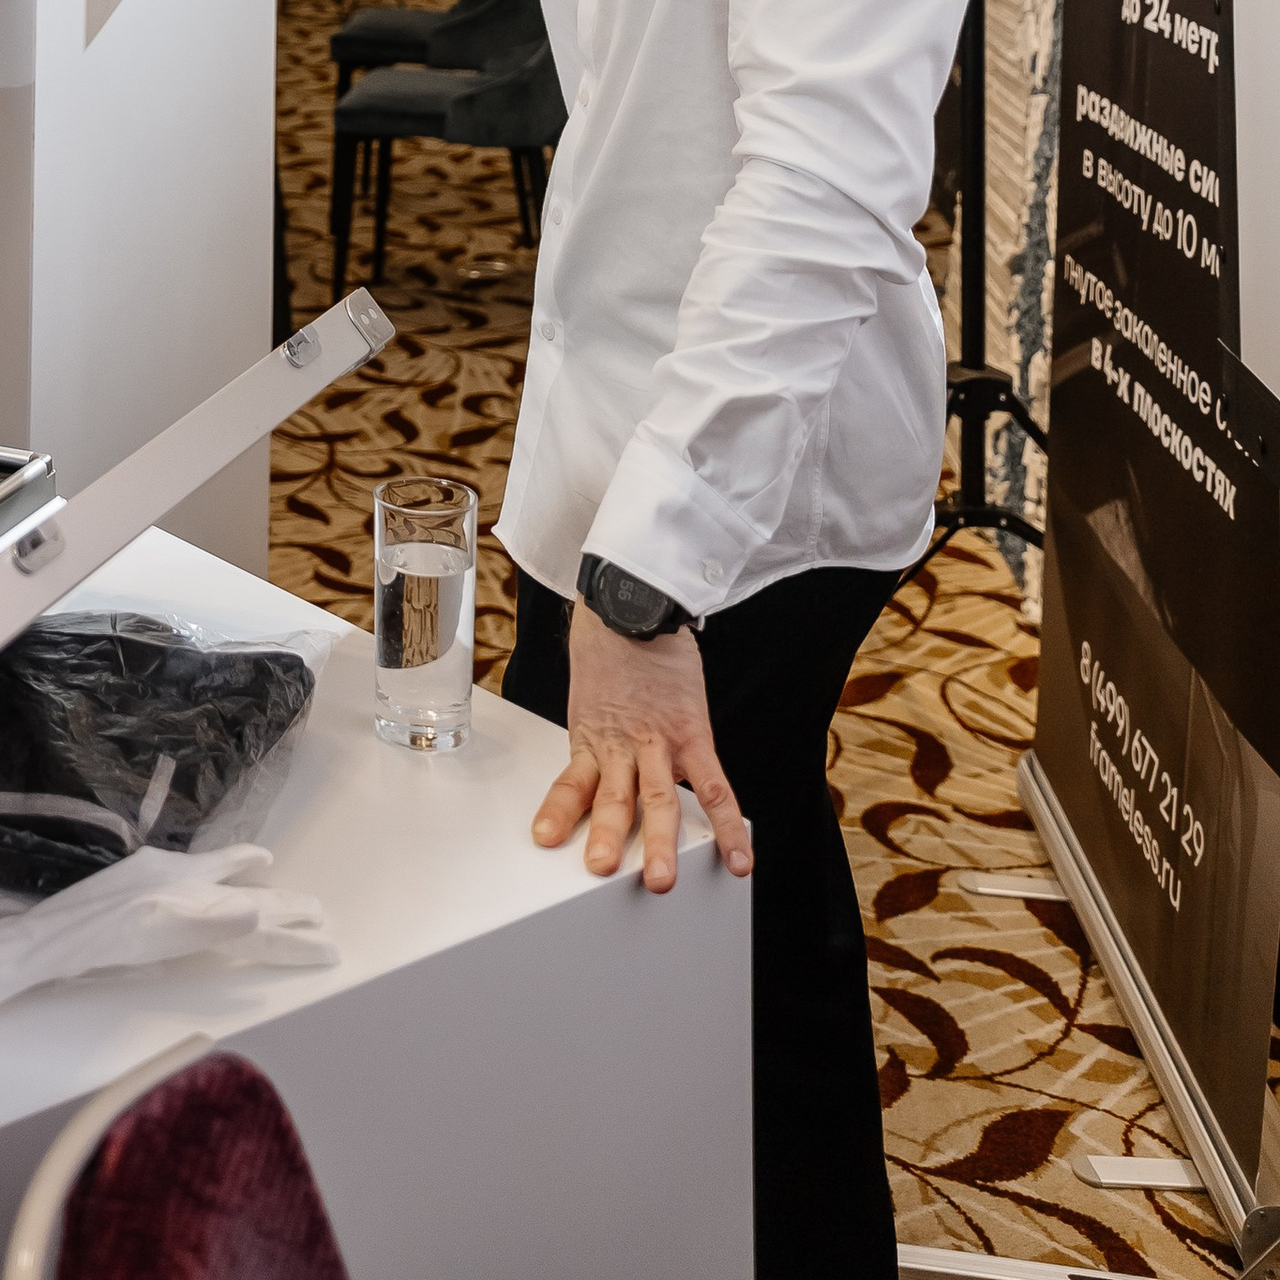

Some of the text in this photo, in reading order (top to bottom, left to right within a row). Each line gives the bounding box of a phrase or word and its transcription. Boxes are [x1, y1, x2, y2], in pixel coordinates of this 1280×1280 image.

[1075, 83, 1186, 182] раздвижные
[1082, 148, 1094, 179] в
[1097, 157, 1153, 232] высоту
[1152, 201, 1173, 241] до
[1176, 208, 1198, 259] 10
[1090, 337, 1102, 371] в
[1132, 381, 1238, 521] плоскостях
[1113, 299, 1212, 415] закаленное
[1079, 640, 1205, 867] 8 (499) 677 21 29
[1089, 720, 1182, 912] frameless.ru
